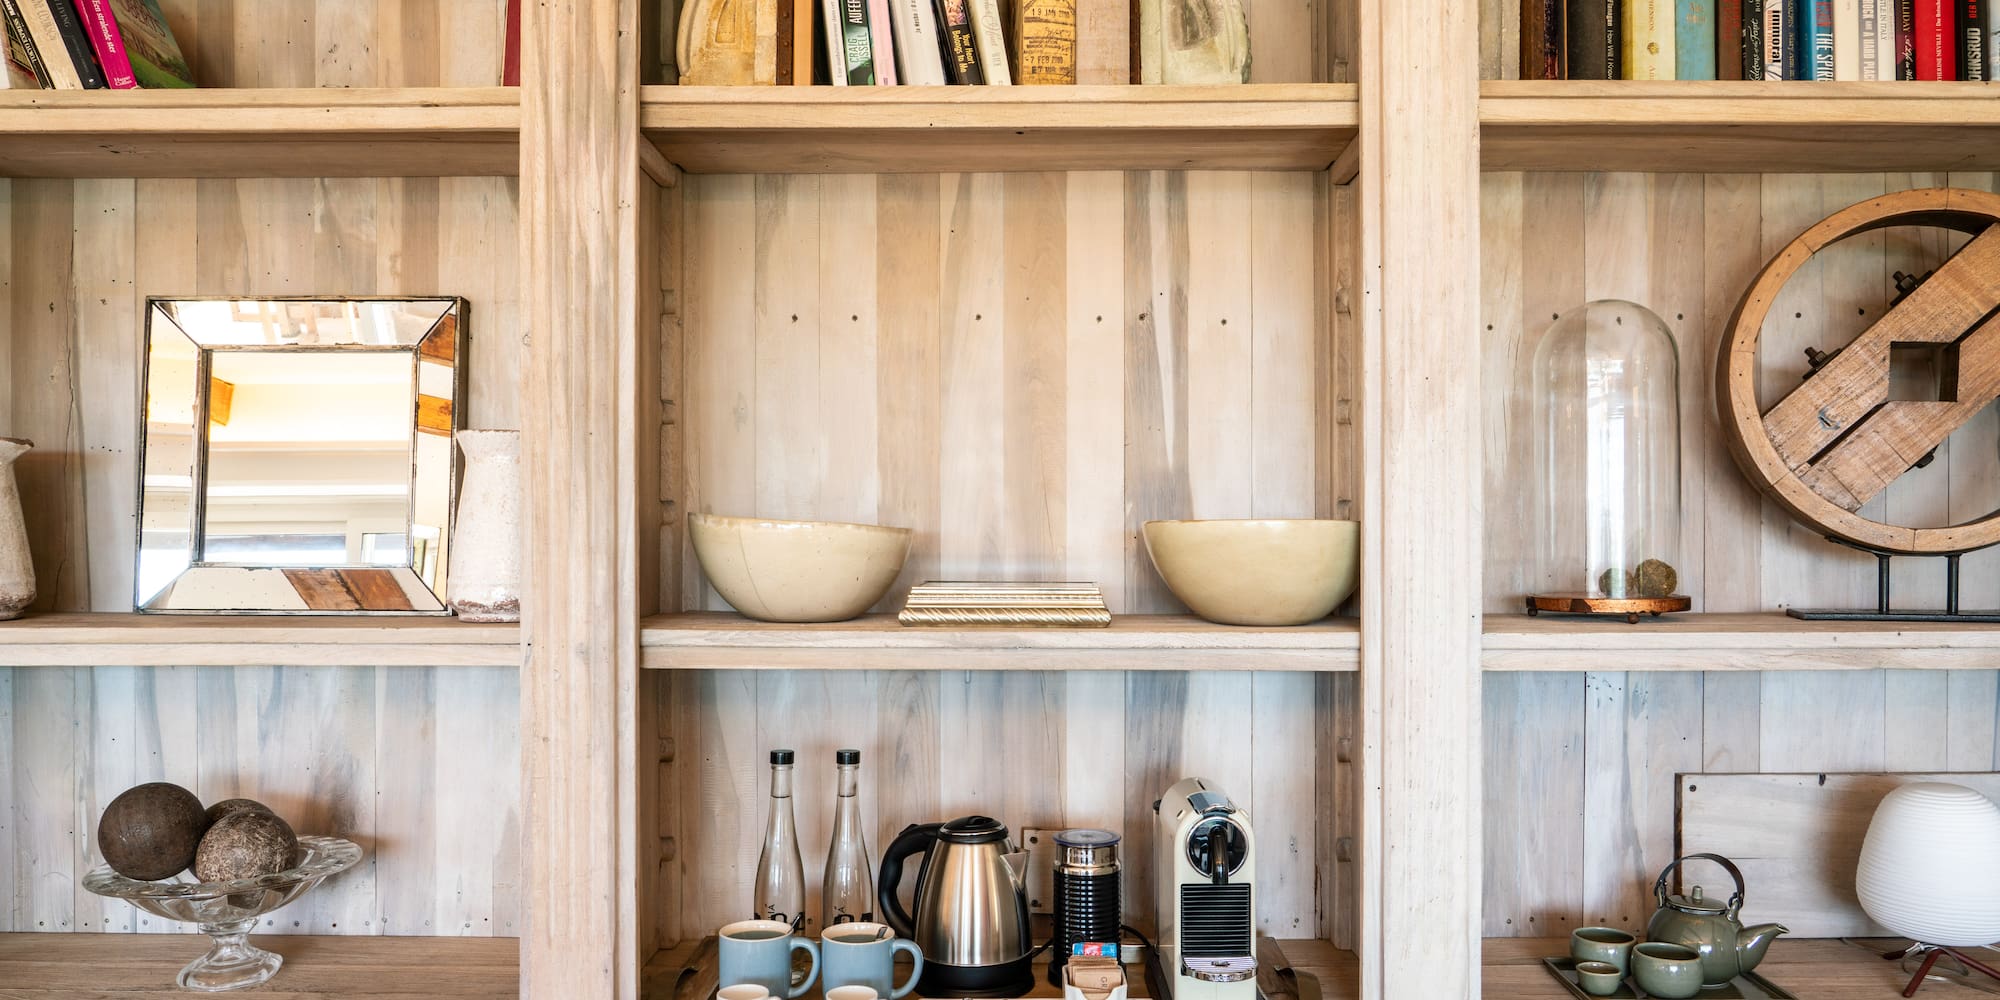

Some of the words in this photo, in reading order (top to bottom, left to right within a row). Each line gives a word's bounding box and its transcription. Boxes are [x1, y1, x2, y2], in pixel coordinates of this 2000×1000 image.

[97, 13, 113, 41] stralende
[107, 41, 116, 54] ster
[962, 34, 971, 46] Your
[1816, 33, 1834, 50] THE
[848, 38, 859, 62] CRAIG
[952, 30, 963, 54] Belongs
[959, 63, 968, 73] Me
[965, 48, 975, 64] Heart
[1864, 40, 1874, 59] HARD
